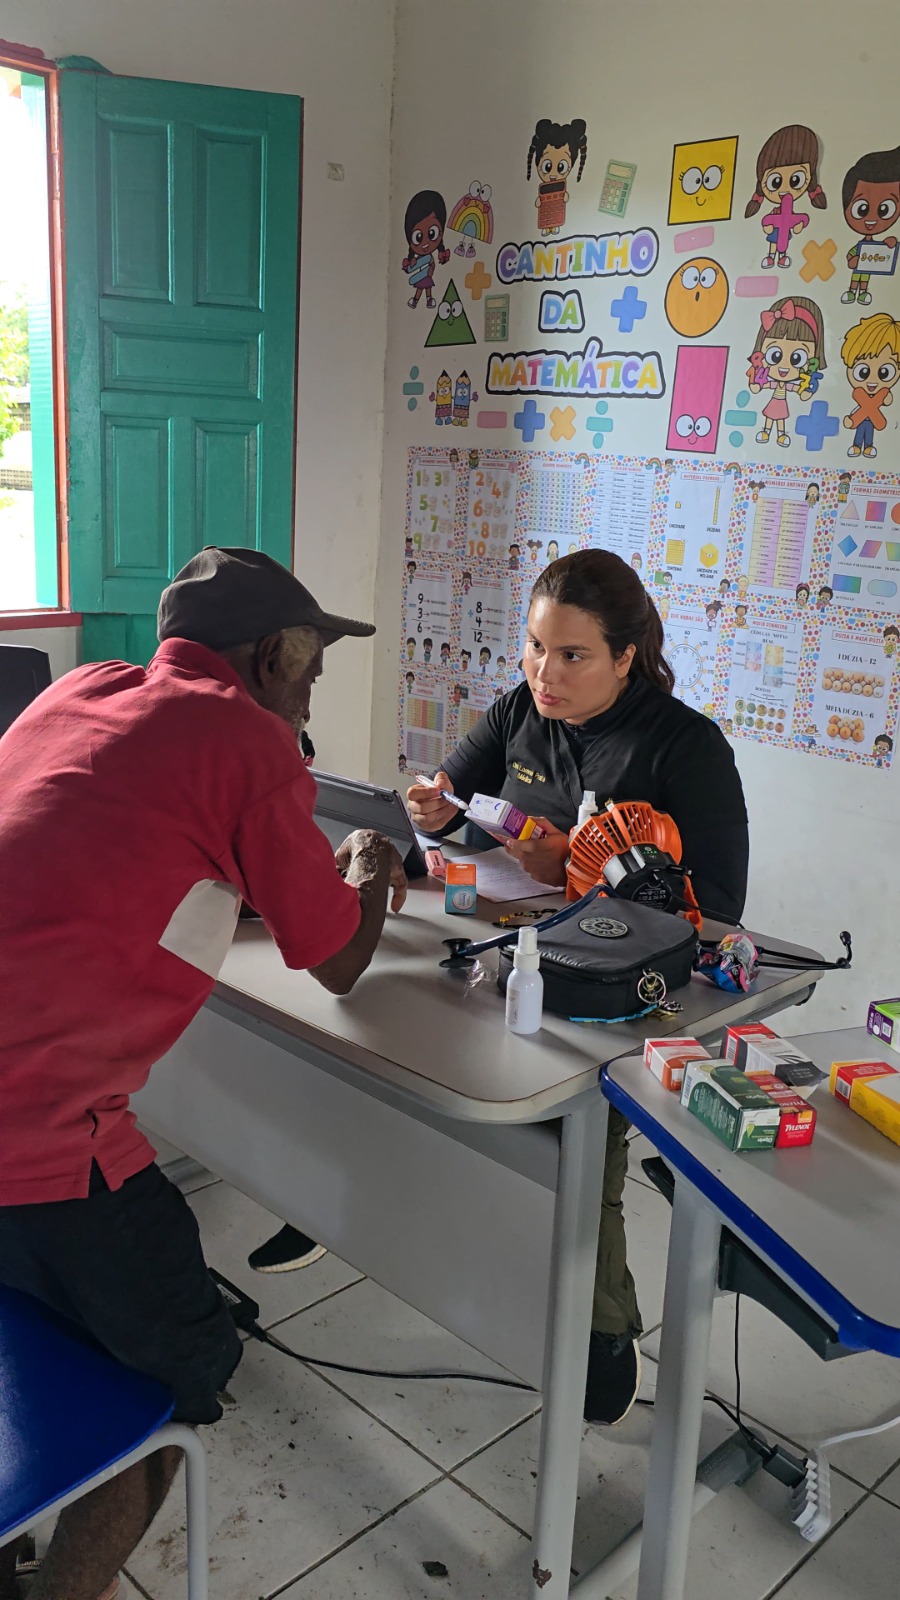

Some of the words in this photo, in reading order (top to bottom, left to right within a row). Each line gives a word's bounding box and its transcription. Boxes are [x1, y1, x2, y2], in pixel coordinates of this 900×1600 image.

[498, 232, 656, 279] CANTINHO
[543, 297, 580, 325] DA
[490, 344, 658, 389] MATEMÁTICA
[416, 470, 421, 487] 1
[434, 471, 442, 487] 3
[475, 471, 485, 487] 2
[491, 481, 502, 499] 4
[420, 494, 428, 511] 5
[473, 500, 484, 517] 6
[431, 514, 439, 533] 7
[481, 521, 490, 539] 8
[413, 532, 423, 552] 9
[469, 539, 487, 557] 10
[418, 592, 424, 605] 9
[417, 607, 423, 619] 3
[475, 601, 483, 614] 8
[417, 621, 423, 633] 6
[475, 616, 482, 628] 4
[473, 630, 483, 643] 12
